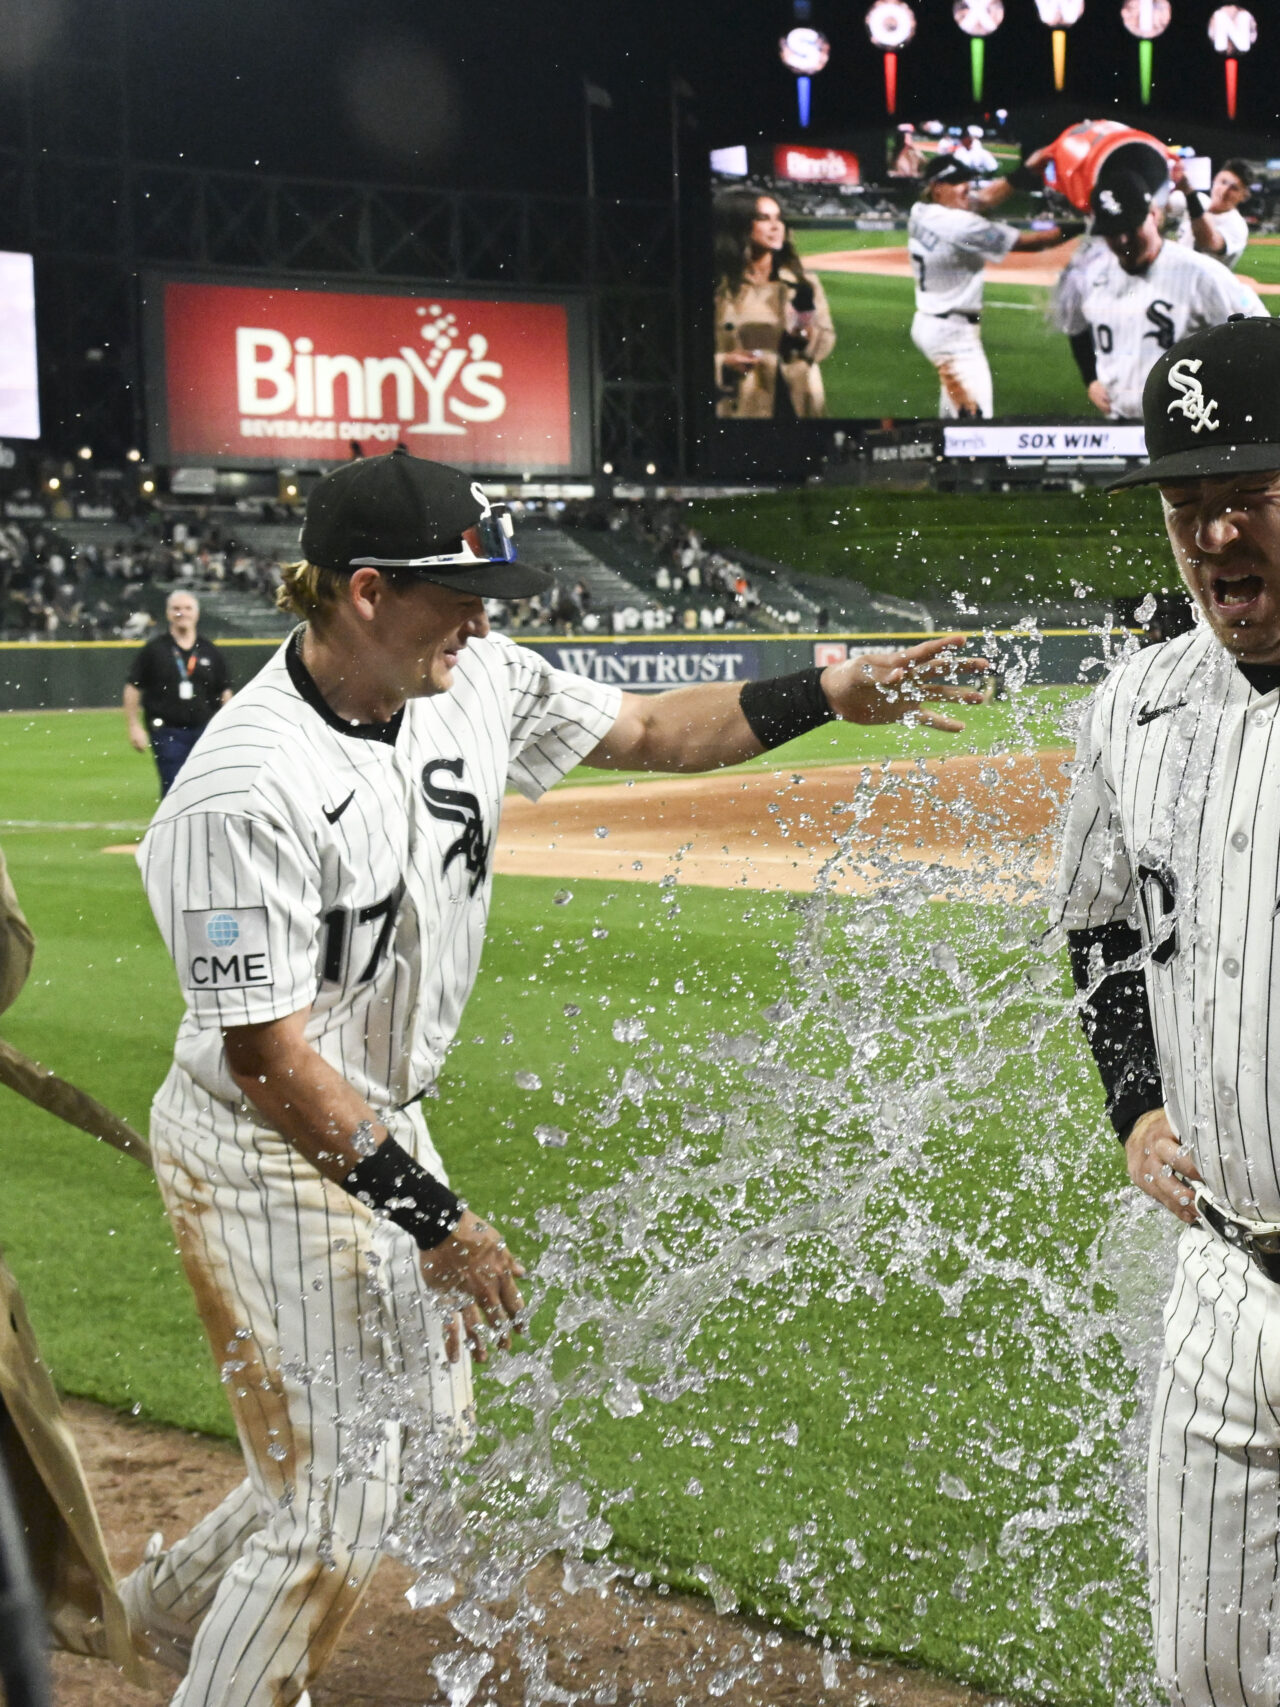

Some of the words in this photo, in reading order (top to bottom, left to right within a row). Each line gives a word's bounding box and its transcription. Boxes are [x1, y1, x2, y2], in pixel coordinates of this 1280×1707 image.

[240, 418, 336, 438] BEVERAGE
[339, 422, 401, 441] DEPOT
[1018, 433, 1056, 449] SOX
[557, 649, 744, 683] WINTRUST
[323, 880, 408, 985] 17
[191, 953, 268, 986] CME
